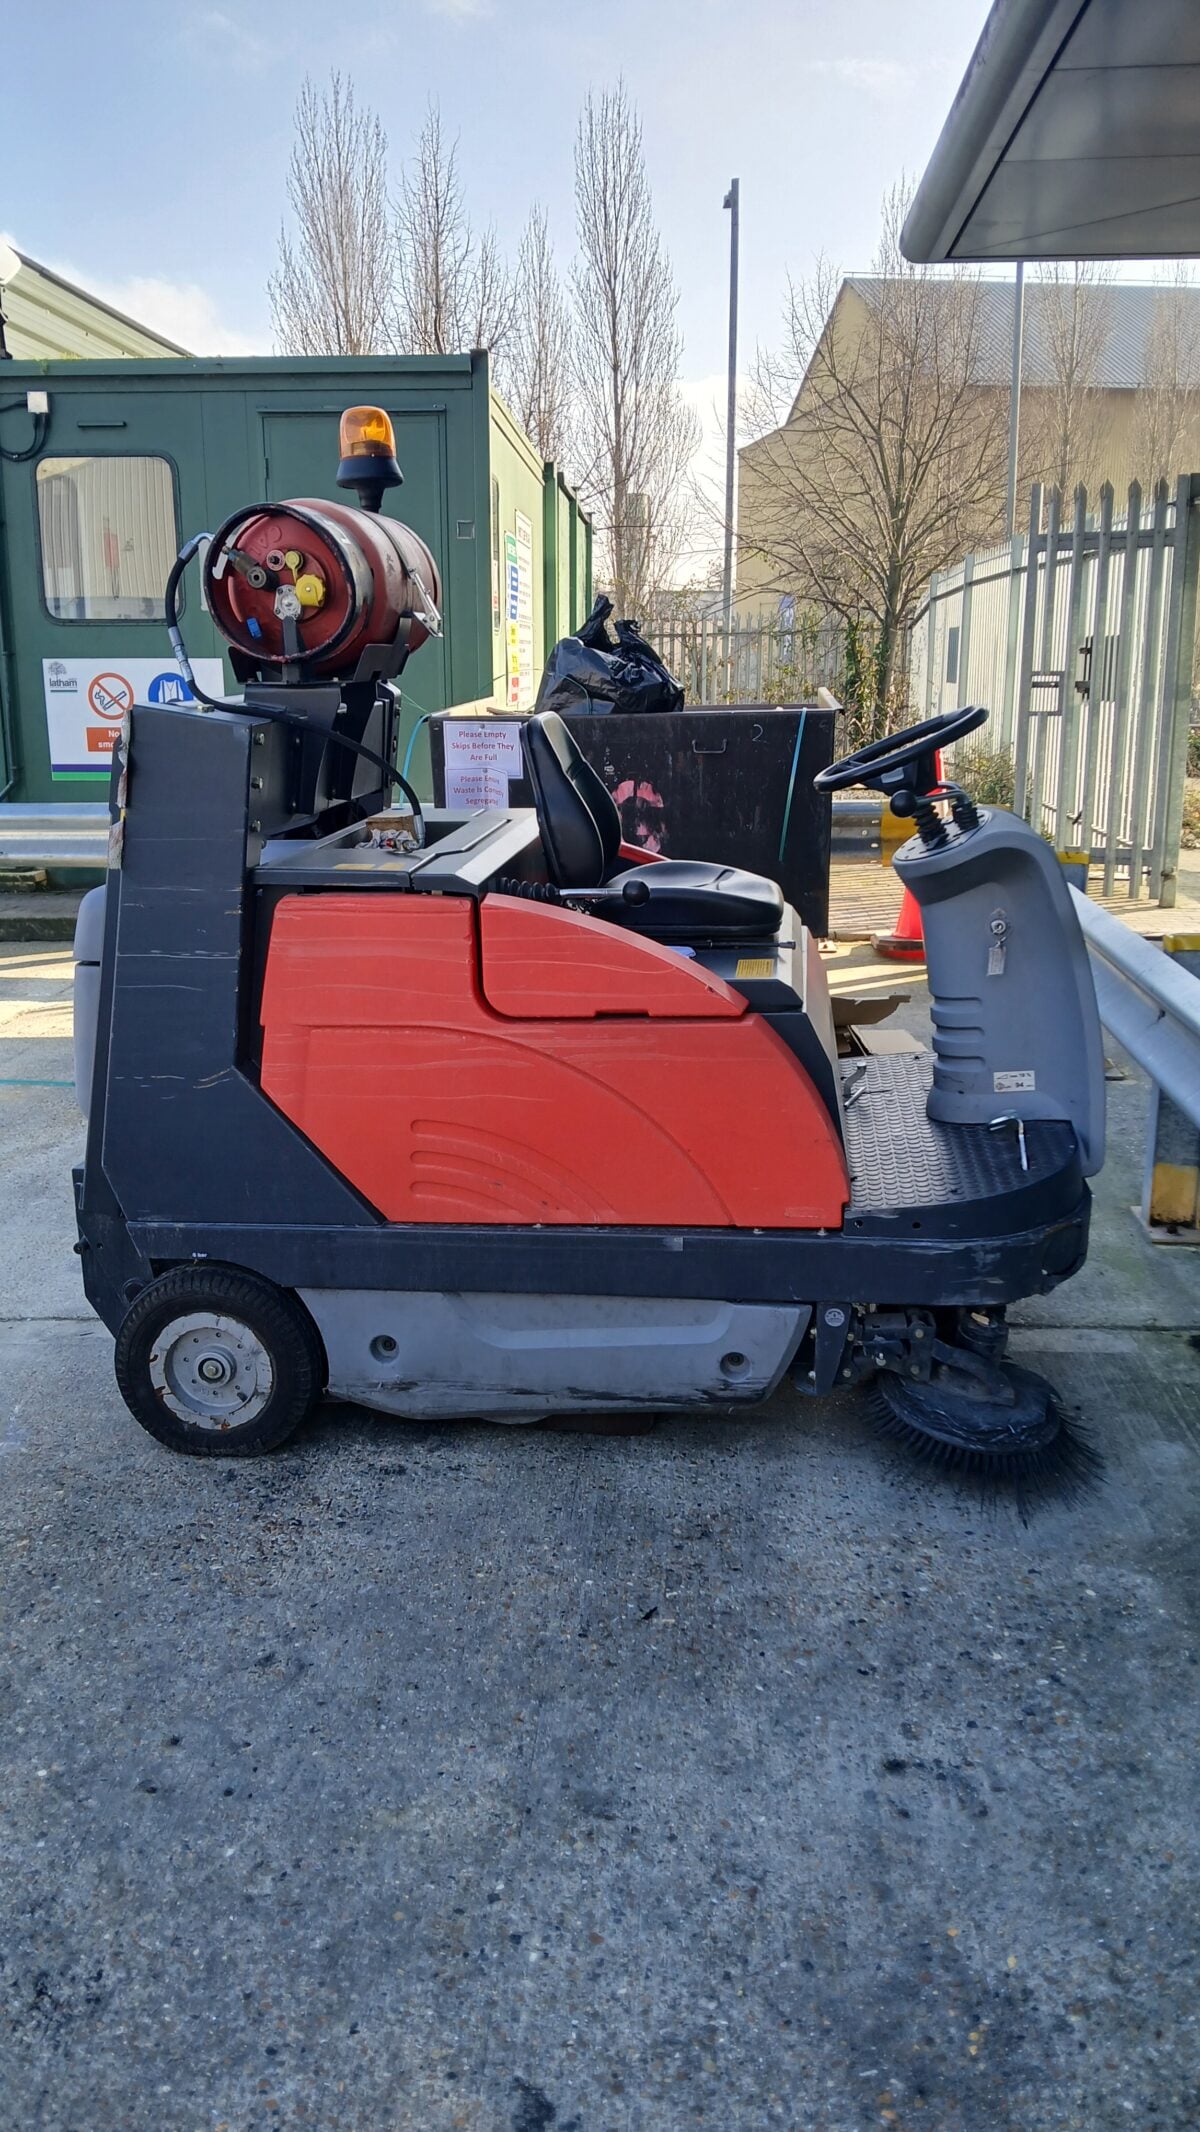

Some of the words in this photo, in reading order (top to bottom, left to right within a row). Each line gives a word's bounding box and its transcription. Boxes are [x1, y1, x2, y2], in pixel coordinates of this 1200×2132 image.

[49, 678, 77, 687] latham
[108, 730, 120, 738] No
[458, 730, 483, 738] Please
[484, 730, 507, 739] Empty
[451, 742, 471, 751] Skips
[472, 742, 496, 750] Before
[497, 742, 515, 751] They
[460, 775, 483, 783] Please
[453, 786, 475, 794] Waste
